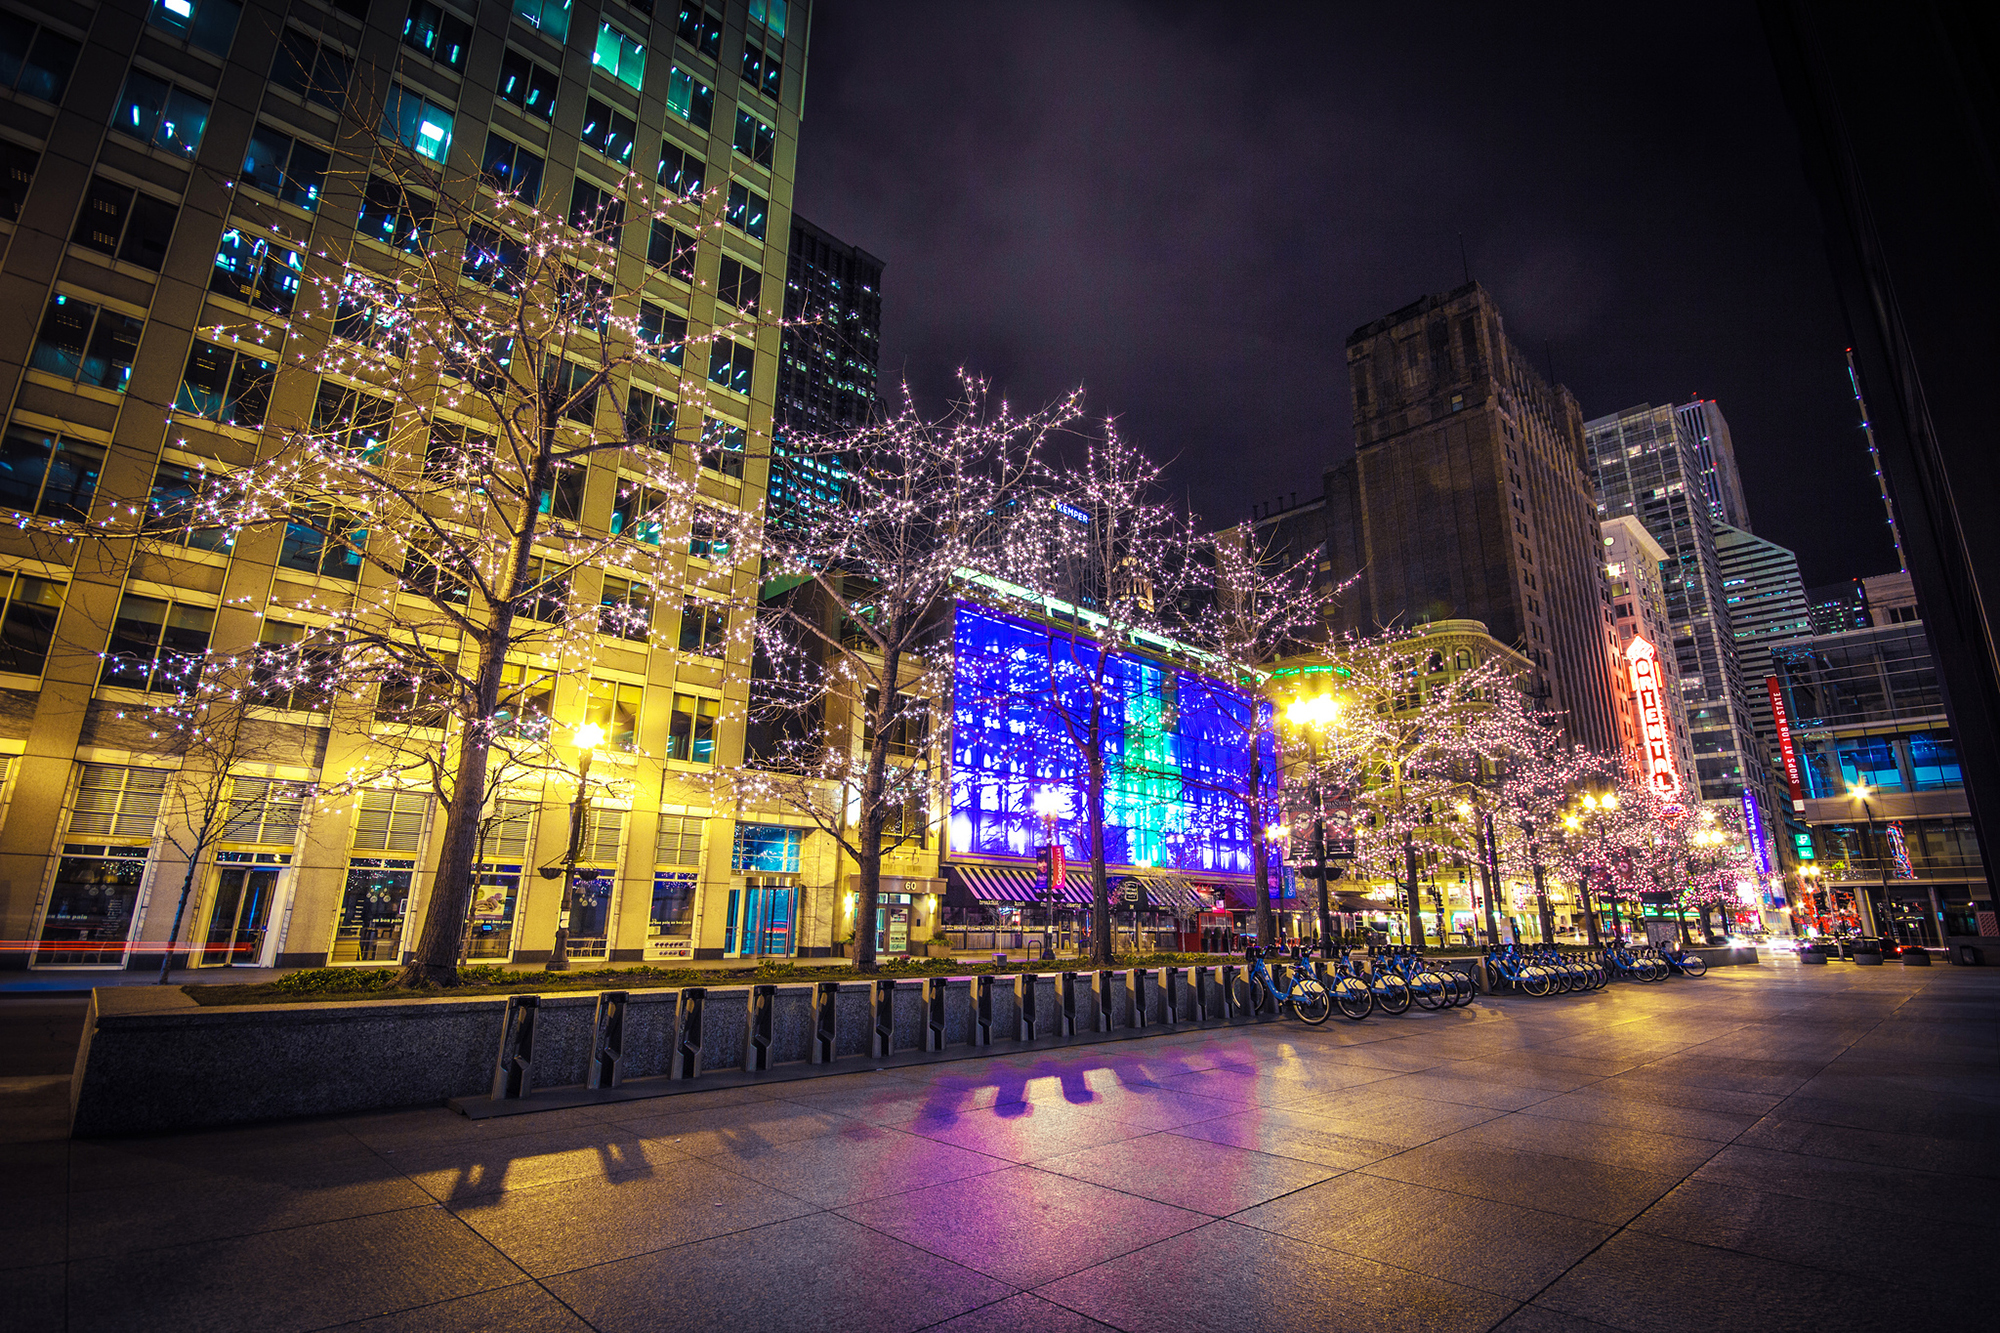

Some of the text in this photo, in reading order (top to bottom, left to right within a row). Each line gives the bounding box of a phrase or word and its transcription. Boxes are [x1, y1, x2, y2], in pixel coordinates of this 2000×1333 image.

[1057, 503, 1088, 524] KEMPER
[1773, 692, 1786, 715] STATE
[1636, 660, 1673, 791] ORIENTAL
[1780, 727, 1791, 742] 108
[1785, 745, 1794, 760] AT
[1787, 758, 1799, 784] SHOPS
[1745, 798, 1757, 830] BALLET
[905, 881, 917, 890] 60
[72, 913, 88, 921] pain
